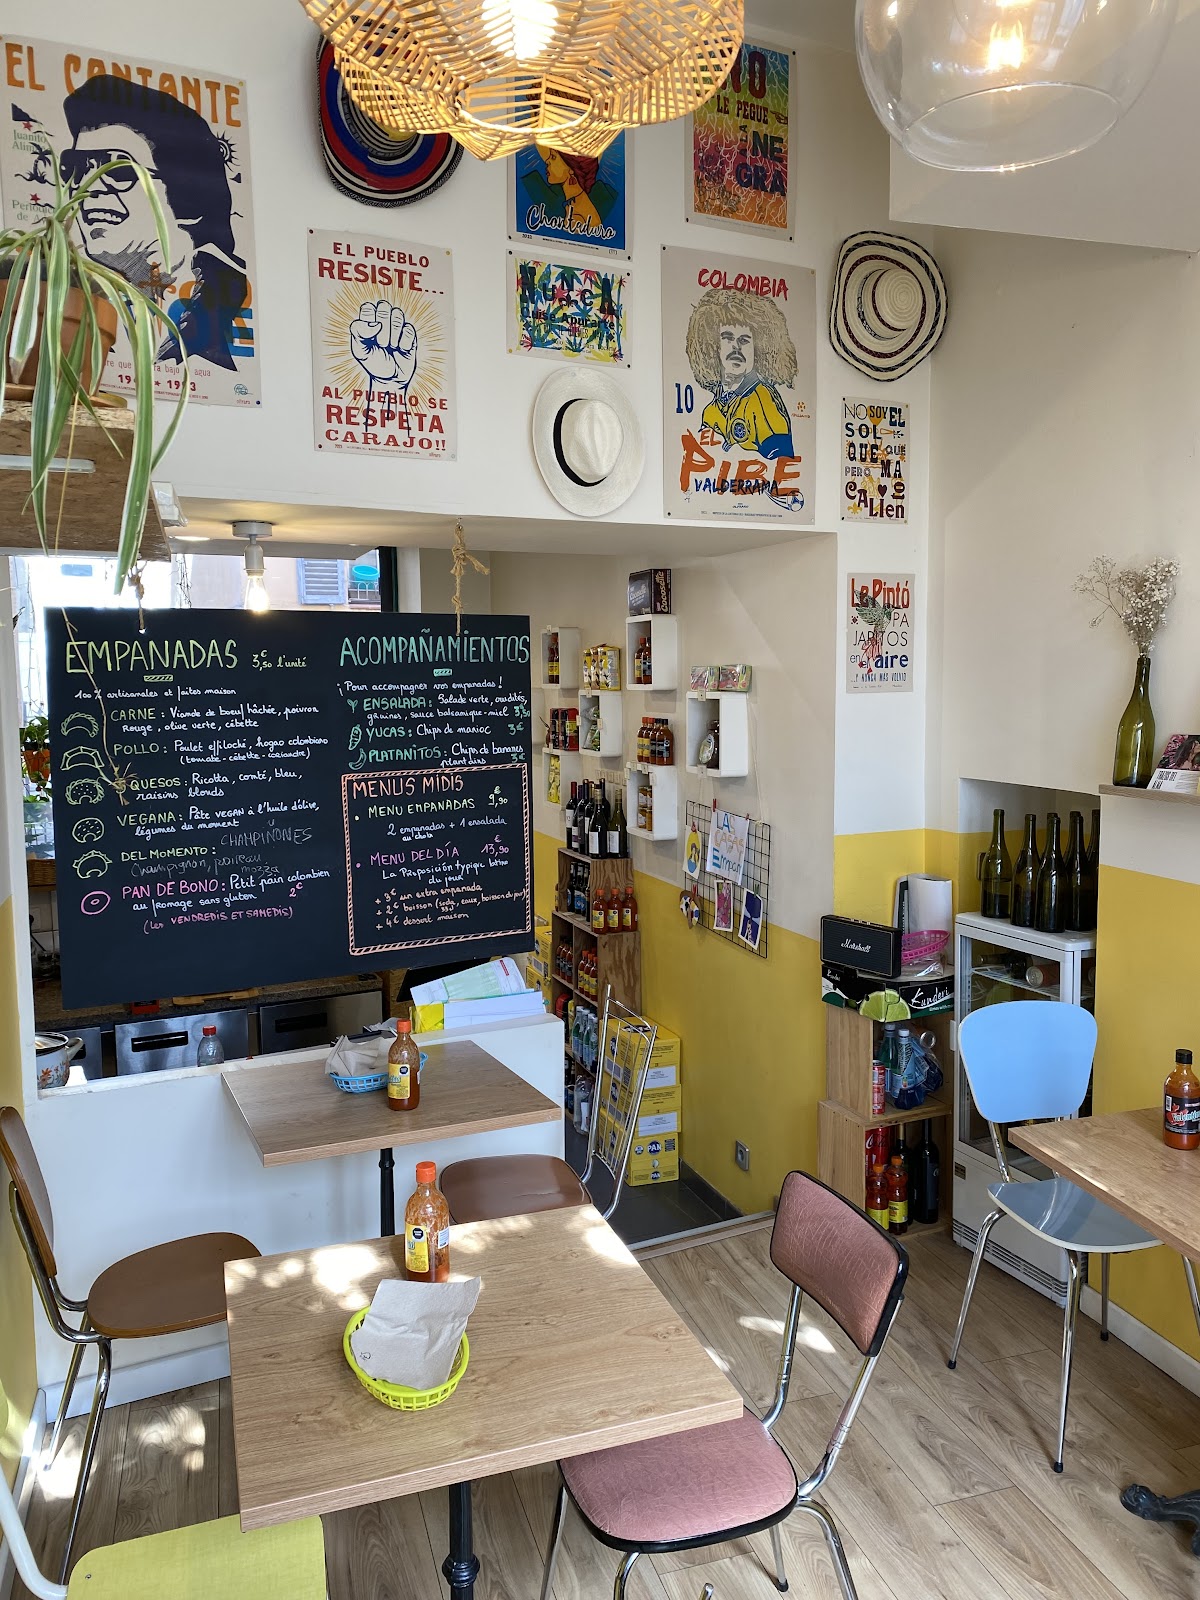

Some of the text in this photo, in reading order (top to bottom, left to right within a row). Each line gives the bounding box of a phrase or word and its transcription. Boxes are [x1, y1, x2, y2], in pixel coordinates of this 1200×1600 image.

[5, 42, 45, 91] EL
[717, 94, 769, 125] LE PEGUE
[752, 130, 784, 163] NE
[735, 162, 786, 197] GRA
[333, 242, 430, 268] EL PUEBLO
[318, 258, 445, 295] RESISTE...
[698, 268, 788, 301] COLOMBIA
[194, 368, 211, 377] agua
[167, 380, 196, 391] 193
[321, 386, 448, 410] AL PUEBLO SE
[675, 382, 694, 414] 10
[326, 404, 445, 434] RESPETA
[844, 403, 905, 427] NO SOY EL
[325, 429, 446, 451] CARAJO!!
[699, 429, 721, 447] EL
[845, 422, 882, 440] SOL
[848, 442, 906, 463] QUE QUE
[694, 478, 779, 497] VALDERRAMA
[65, 639, 238, 674] EMPANADAS
[339, 627, 530, 667] ACOMPAÑAMIENTOS
[874, 651, 909, 669] aire
[106, 688, 158, 699] artisanales
[164, 688, 173, 697] et
[204, 687, 237, 695] maison
[371, 682, 428, 695] accompagner
[169, 705, 202, 718] Viande
[205, 708, 216, 717] de
[283, 703, 320, 720] poivron
[410, 710, 435, 719] sauce
[164, 720, 189, 731] olive
[416, 723, 442, 741] Chips
[443, 722, 454, 734] de
[456, 725, 492, 735] manioc
[174, 739, 205, 752] Poulet
[255, 736, 285, 753] hogao
[451, 741, 478, 757] Chips
[479, 742, 490, 755] de
[135, 786, 225, 801] raisins blonds
[352, 772, 464, 800] MENUS MIDIS
[214, 807, 245, 818] VEGAN
[247, 806, 255, 816] à
[368, 798, 476, 819] MENU EMPANADAS
[134, 819, 240, 841] légumes du moment
[387, 823, 397, 836] 2
[399, 822, 446, 837] empanadas
[467, 815, 508, 827] ensalada
[716, 812, 736, 836] LAS
[121, 851, 147, 862] DEL
[370, 841, 460, 867] MENU DEL DÍA
[382, 869, 398, 880] La
[428, 875, 442, 885] du
[122, 884, 151, 900] PAN
[156, 881, 176, 897] DE
[229, 873, 256, 890] Petit
[258, 874, 284, 893] pain
[287, 869, 331, 882] colombien
[399, 892, 414, 901] un
[415, 887, 439, 899] extra
[440, 881, 483, 897] empanada
[132, 903, 149, 911] au
[198, 898, 221, 906] sans
[222, 893, 258, 908] gluten
[402, 902, 433, 912] boisson
[231, 910, 244, 920] ET
[436, 912, 470, 921] maison
[840, 938, 872, 953] Marshall
[647, 1142, 662, 1153] PAN
